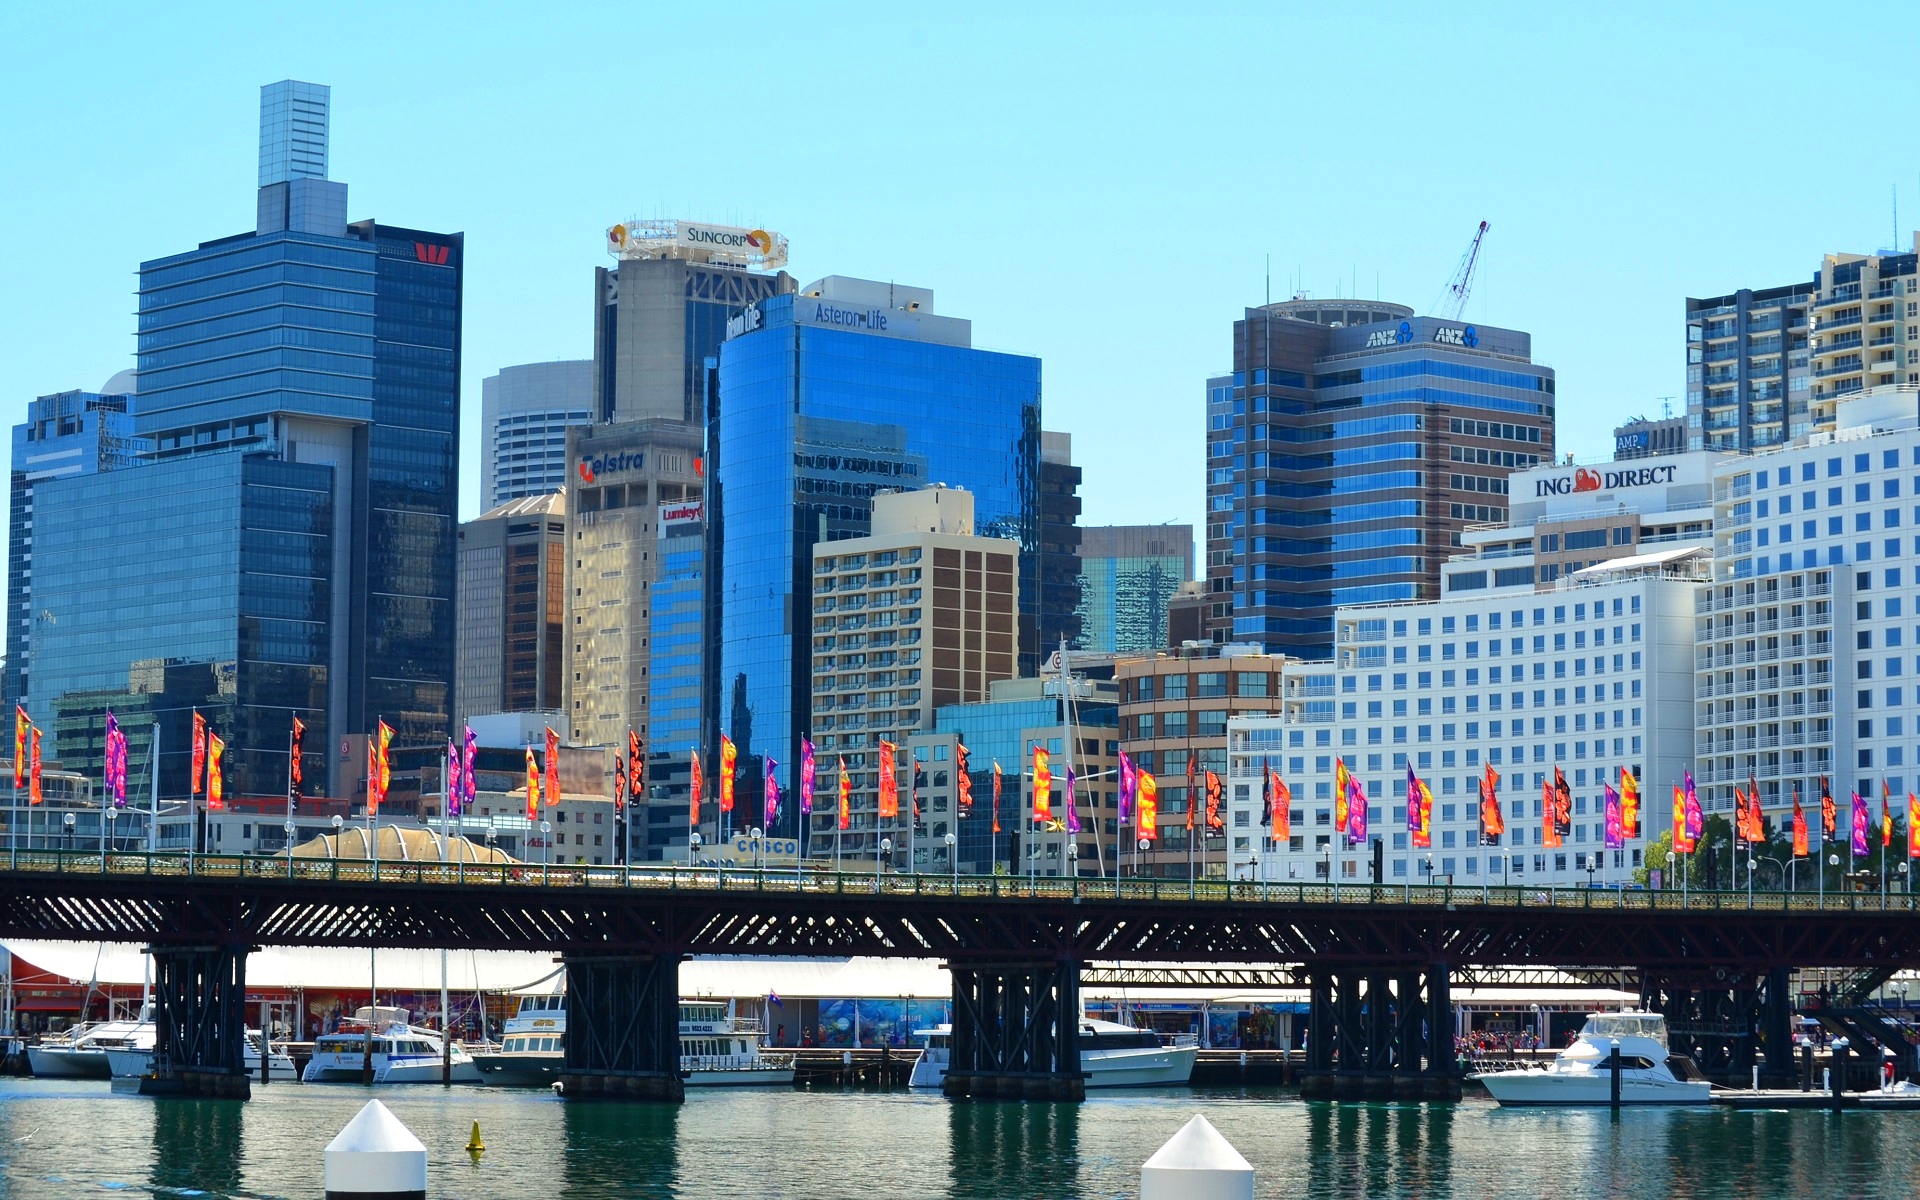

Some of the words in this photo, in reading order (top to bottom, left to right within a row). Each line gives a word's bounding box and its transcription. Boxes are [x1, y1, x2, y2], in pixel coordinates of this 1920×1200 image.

[688, 228, 746, 247] SUNCORP
[815, 303, 861, 328] Asteron
[866, 309, 887, 331] Life
[1366, 329, 1397, 348] ANZ
[1434, 327, 1464, 345] ANZ
[1617, 434, 1639, 449] AMP
[579, 452, 643, 483] Telstra
[1536, 477, 1571, 497] ING
[1604, 465, 1676, 489] DIRECT
[663, 506, 700, 520] Lumley
